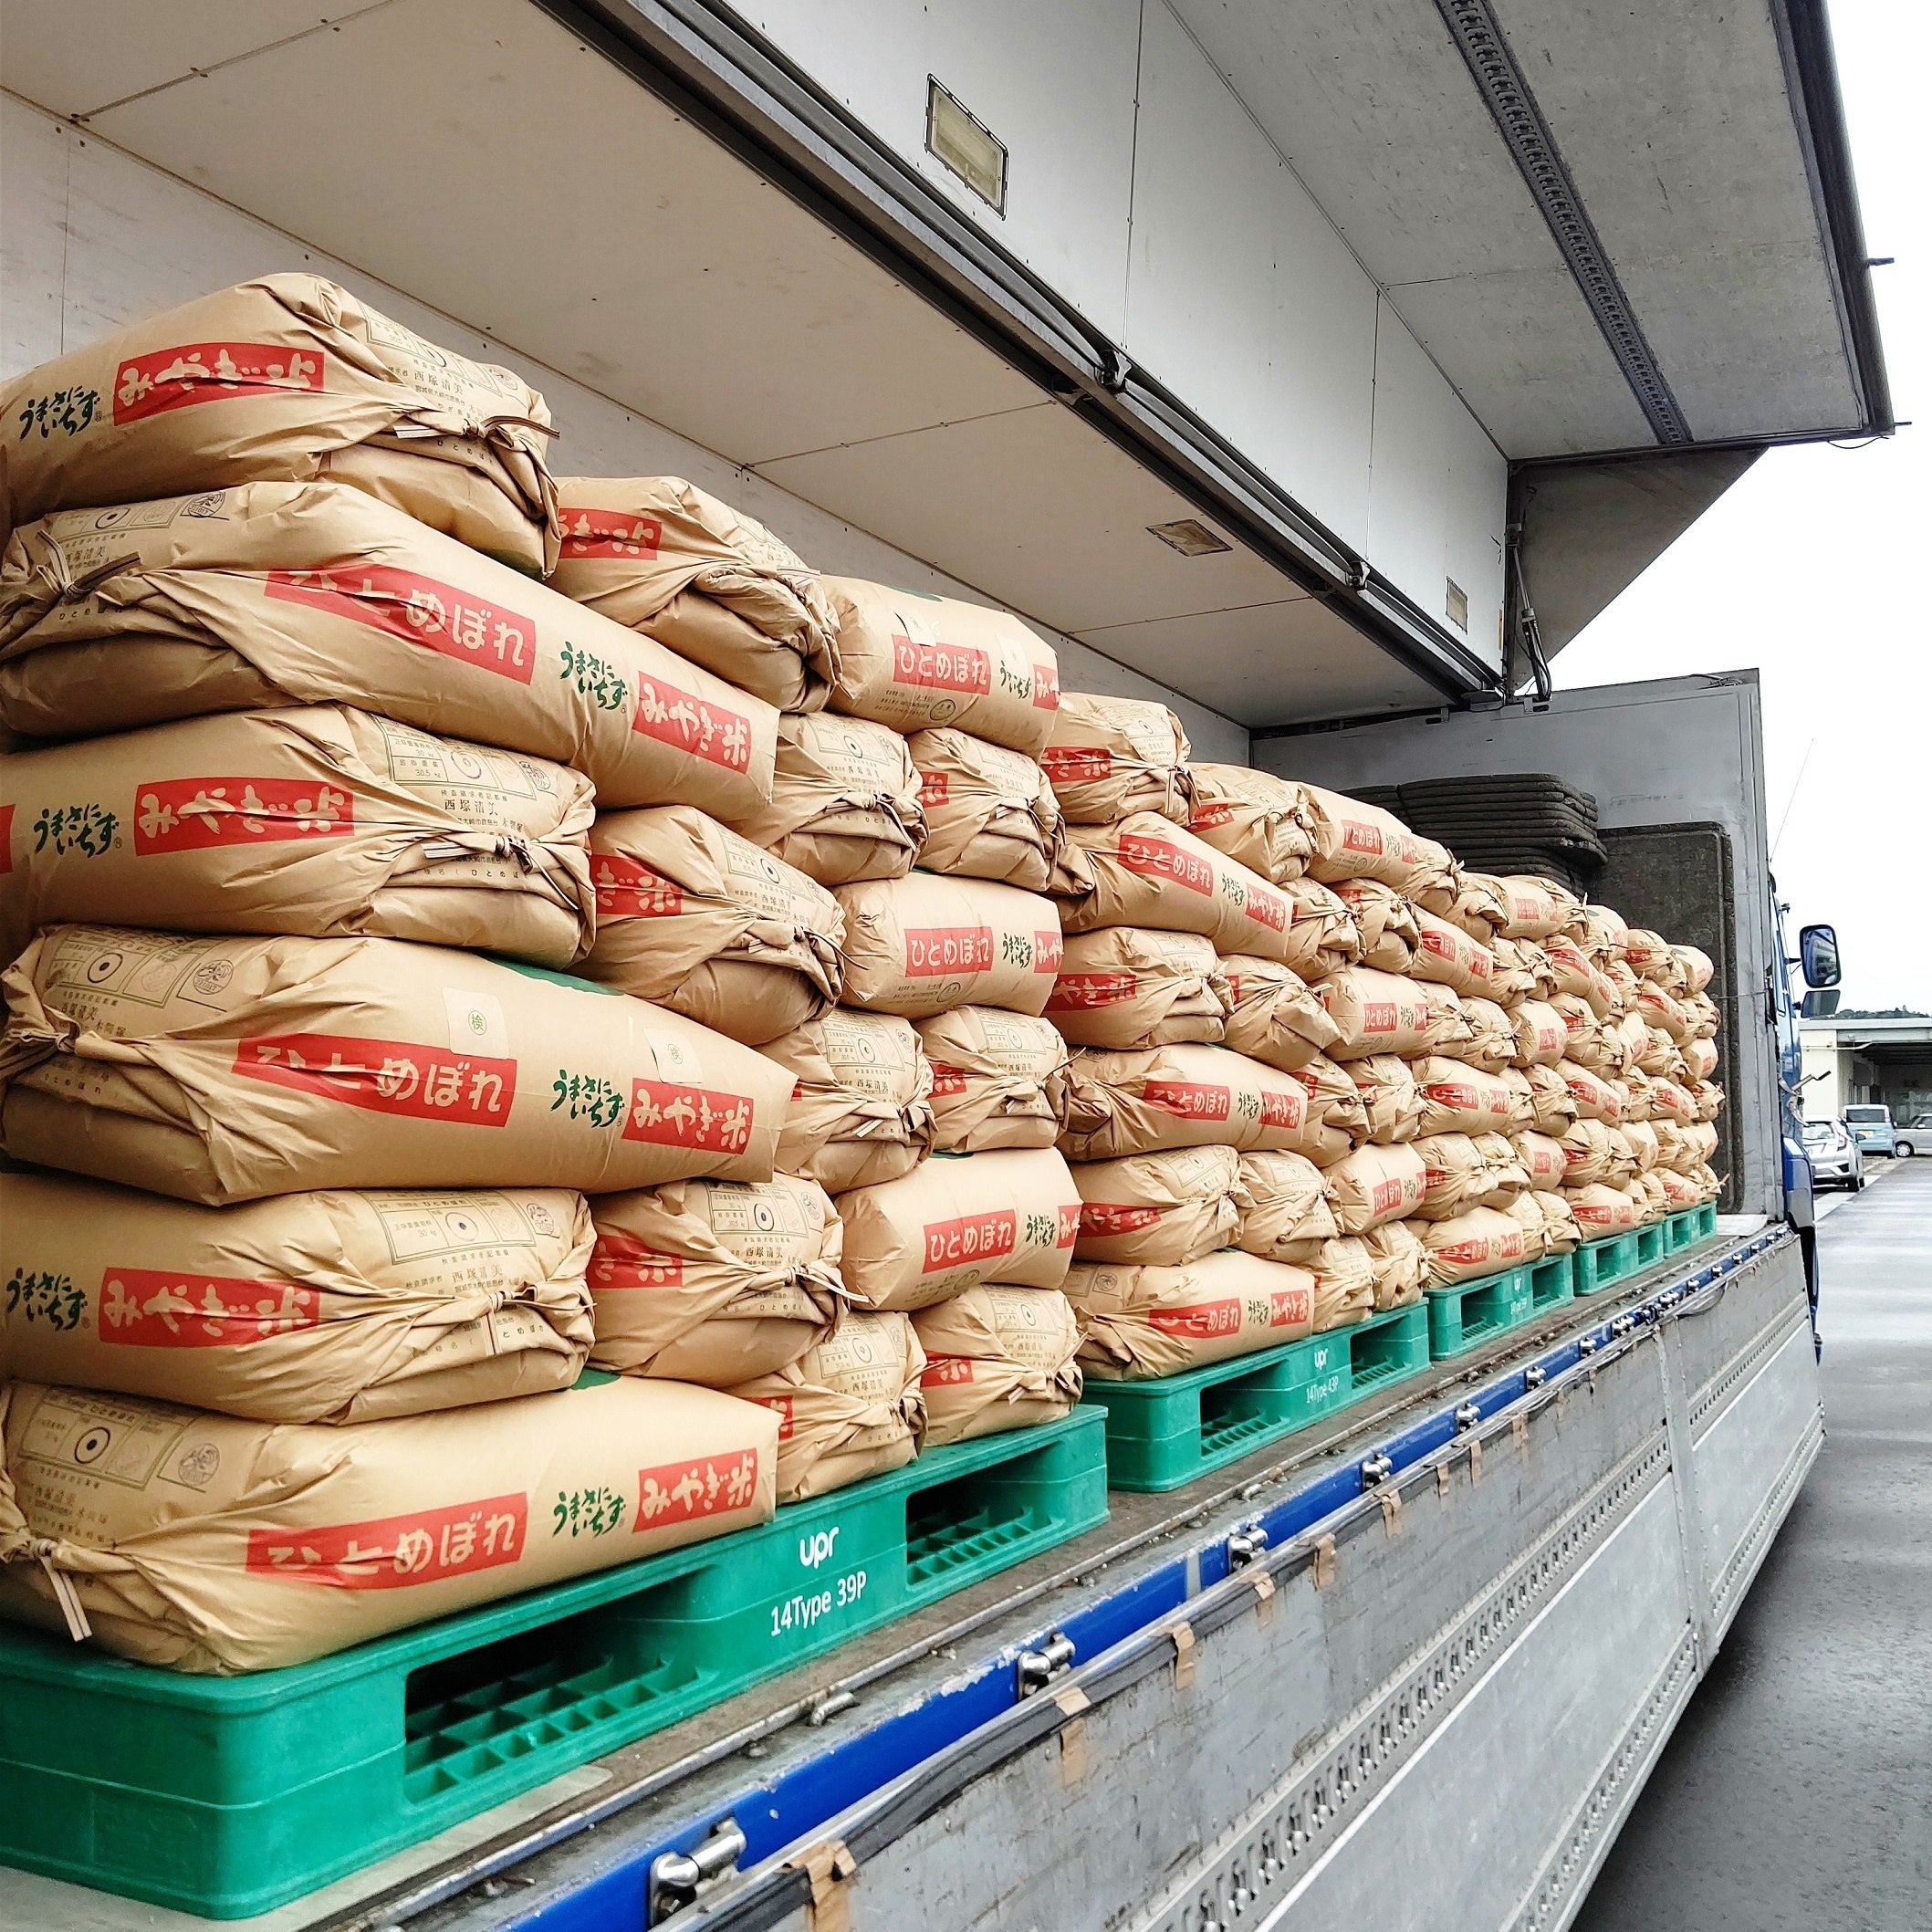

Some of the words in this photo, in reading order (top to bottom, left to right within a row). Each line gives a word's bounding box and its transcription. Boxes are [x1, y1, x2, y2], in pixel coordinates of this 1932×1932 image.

[559, 513, 654, 553] ぎ米
[560, 642, 615, 679] うまさに
[899, 644, 987, 685] ひとめぼれ
[578, 679, 628, 710] いちず
[642, 683, 747, 766] みやぎ米
[139, 785, 345, 839] みやぎ米
[597, 862, 677, 913] ぎ米
[1127, 844, 1211, 889] ひとめぼれ
[1248, 888, 1285, 929] みやぎ米
[911, 935, 990, 966] ひとめぼれ
[551, 1069, 611, 1111] うまさに
[571, 1093, 624, 1128] いちず
[632, 1088, 749, 1149] みやぎ米
[930, 1218, 1012, 1263] ひとめぼれ
[104, 1279, 312, 1334] みやぎ米
[1314, 1348, 1329, 1370] upr
[1306, 1384, 1327, 1404] 14Type
[642, 1453, 756, 1517] みやぎ米
[268, 1510, 516, 1576] ひとめぼれ
[799, 1526, 840, 1569] upr
[770, 1591, 831, 1636] 14Type
[837, 1571, 866, 1607] 39P
